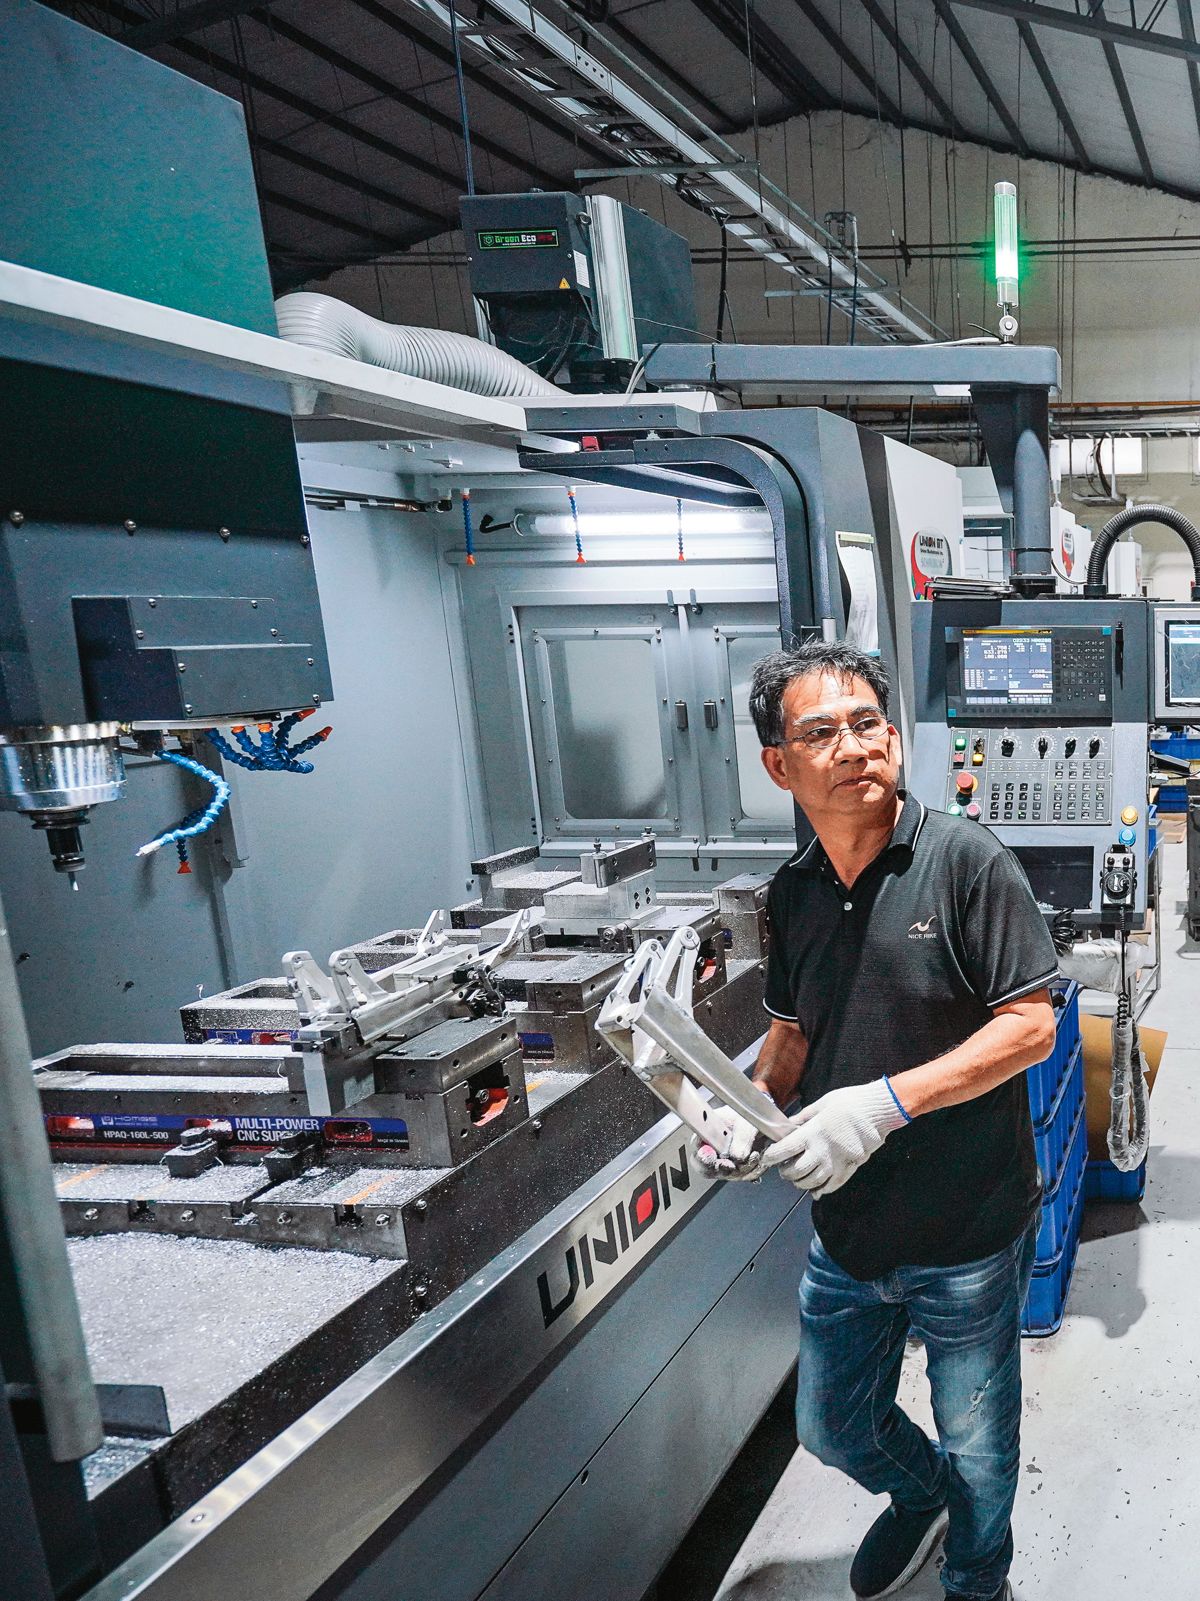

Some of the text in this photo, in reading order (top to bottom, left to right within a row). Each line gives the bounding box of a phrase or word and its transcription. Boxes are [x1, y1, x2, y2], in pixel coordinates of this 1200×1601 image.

[521, 234, 537, 242] Eco
[234, 1117, 320, 1130] MULTI-POWER
[237, 1130, 260, 1142] CNC
[537, 1144, 690, 1329] UNION
